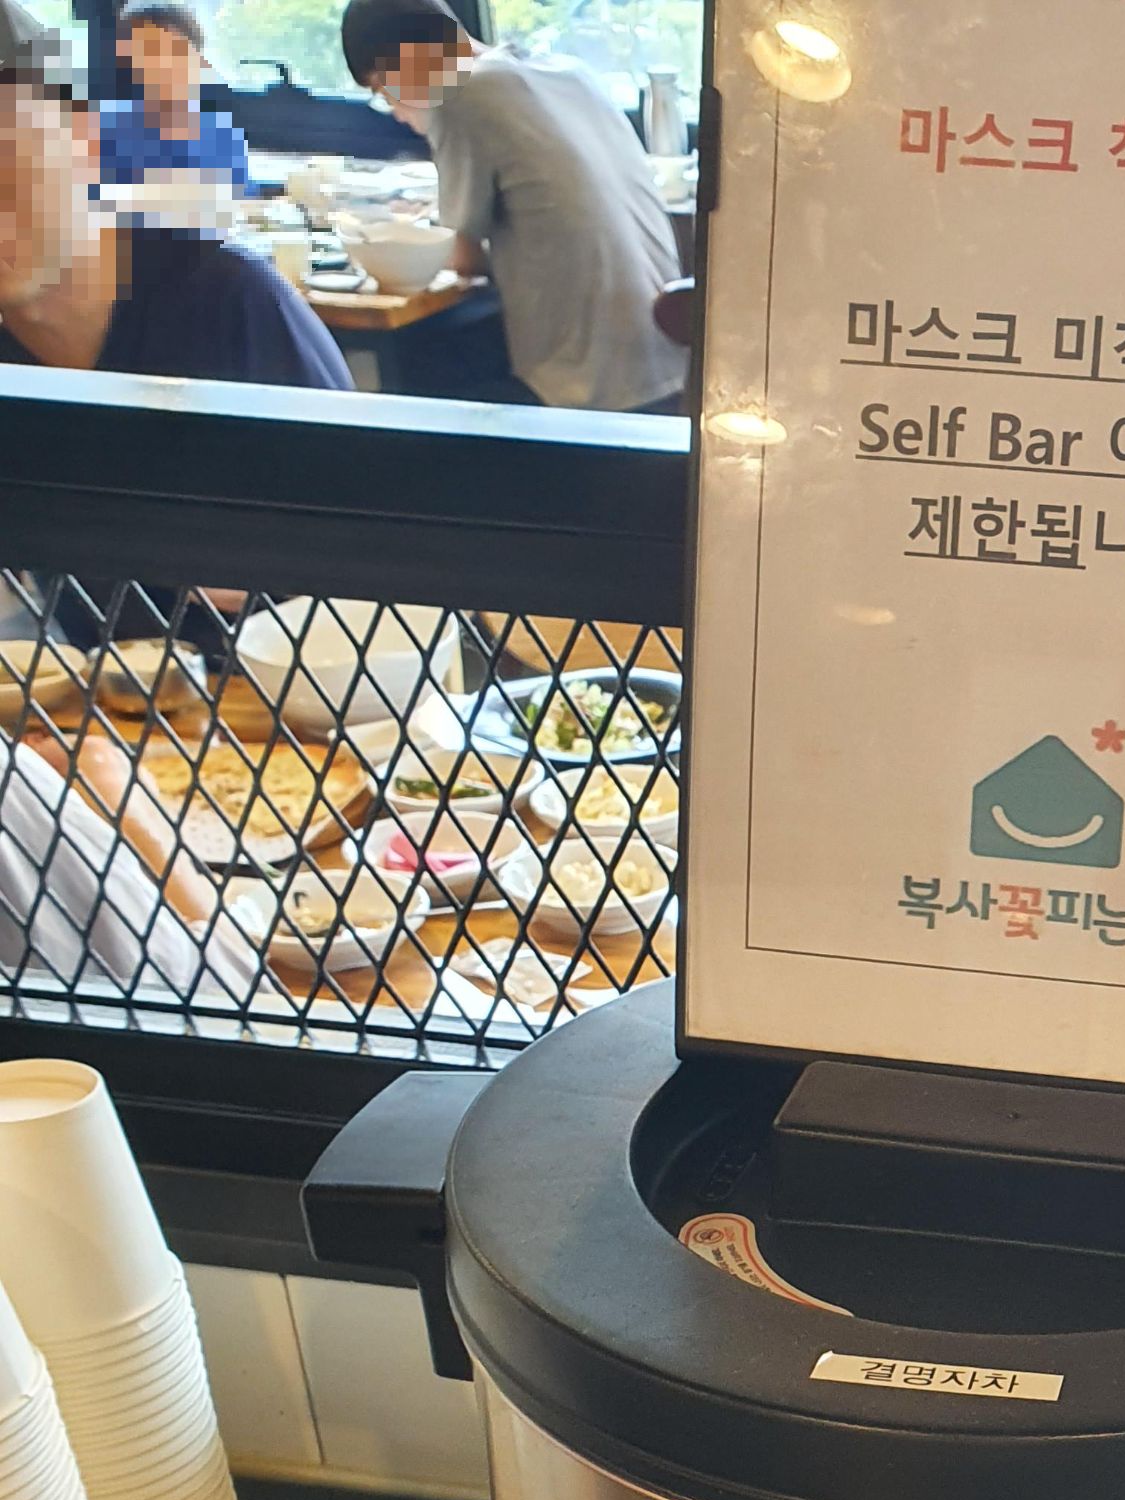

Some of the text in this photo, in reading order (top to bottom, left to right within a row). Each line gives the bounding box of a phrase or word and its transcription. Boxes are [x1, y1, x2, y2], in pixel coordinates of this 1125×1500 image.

[900, 106, 1079, 173] 마스크
[847, 300, 1022, 366] 마스크
[858, 403, 967, 458] Self
[989, 412, 1083, 467] Bar
[860, 1361, 1019, 1394] 결명자차
